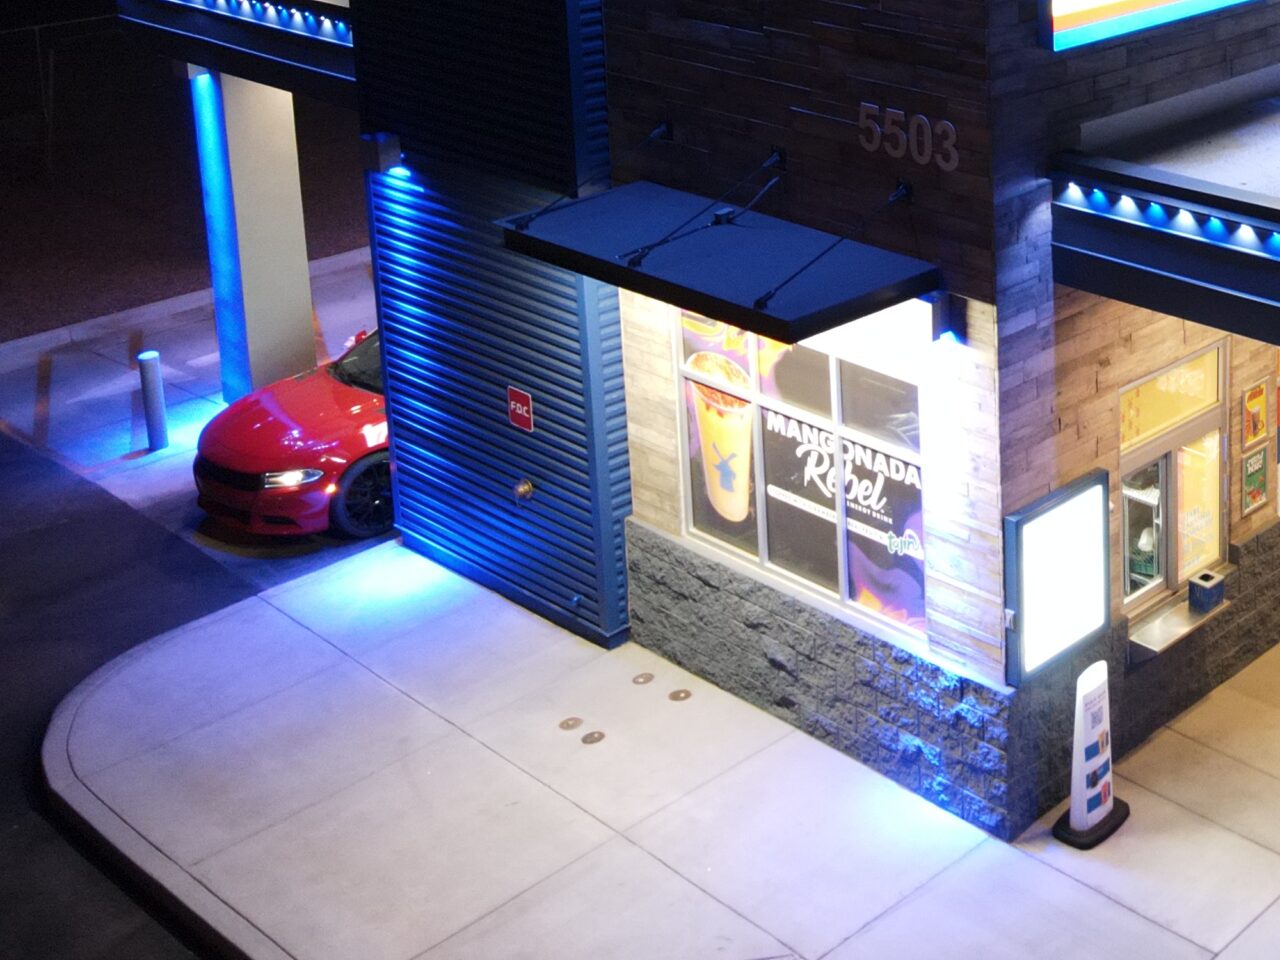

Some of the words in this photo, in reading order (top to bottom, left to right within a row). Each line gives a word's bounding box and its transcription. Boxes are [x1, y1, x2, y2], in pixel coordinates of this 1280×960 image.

[858, 101, 960, 172] 5503
[766, 410, 922, 490] MANGONADA
[795, 443, 887, 510] Rebel
